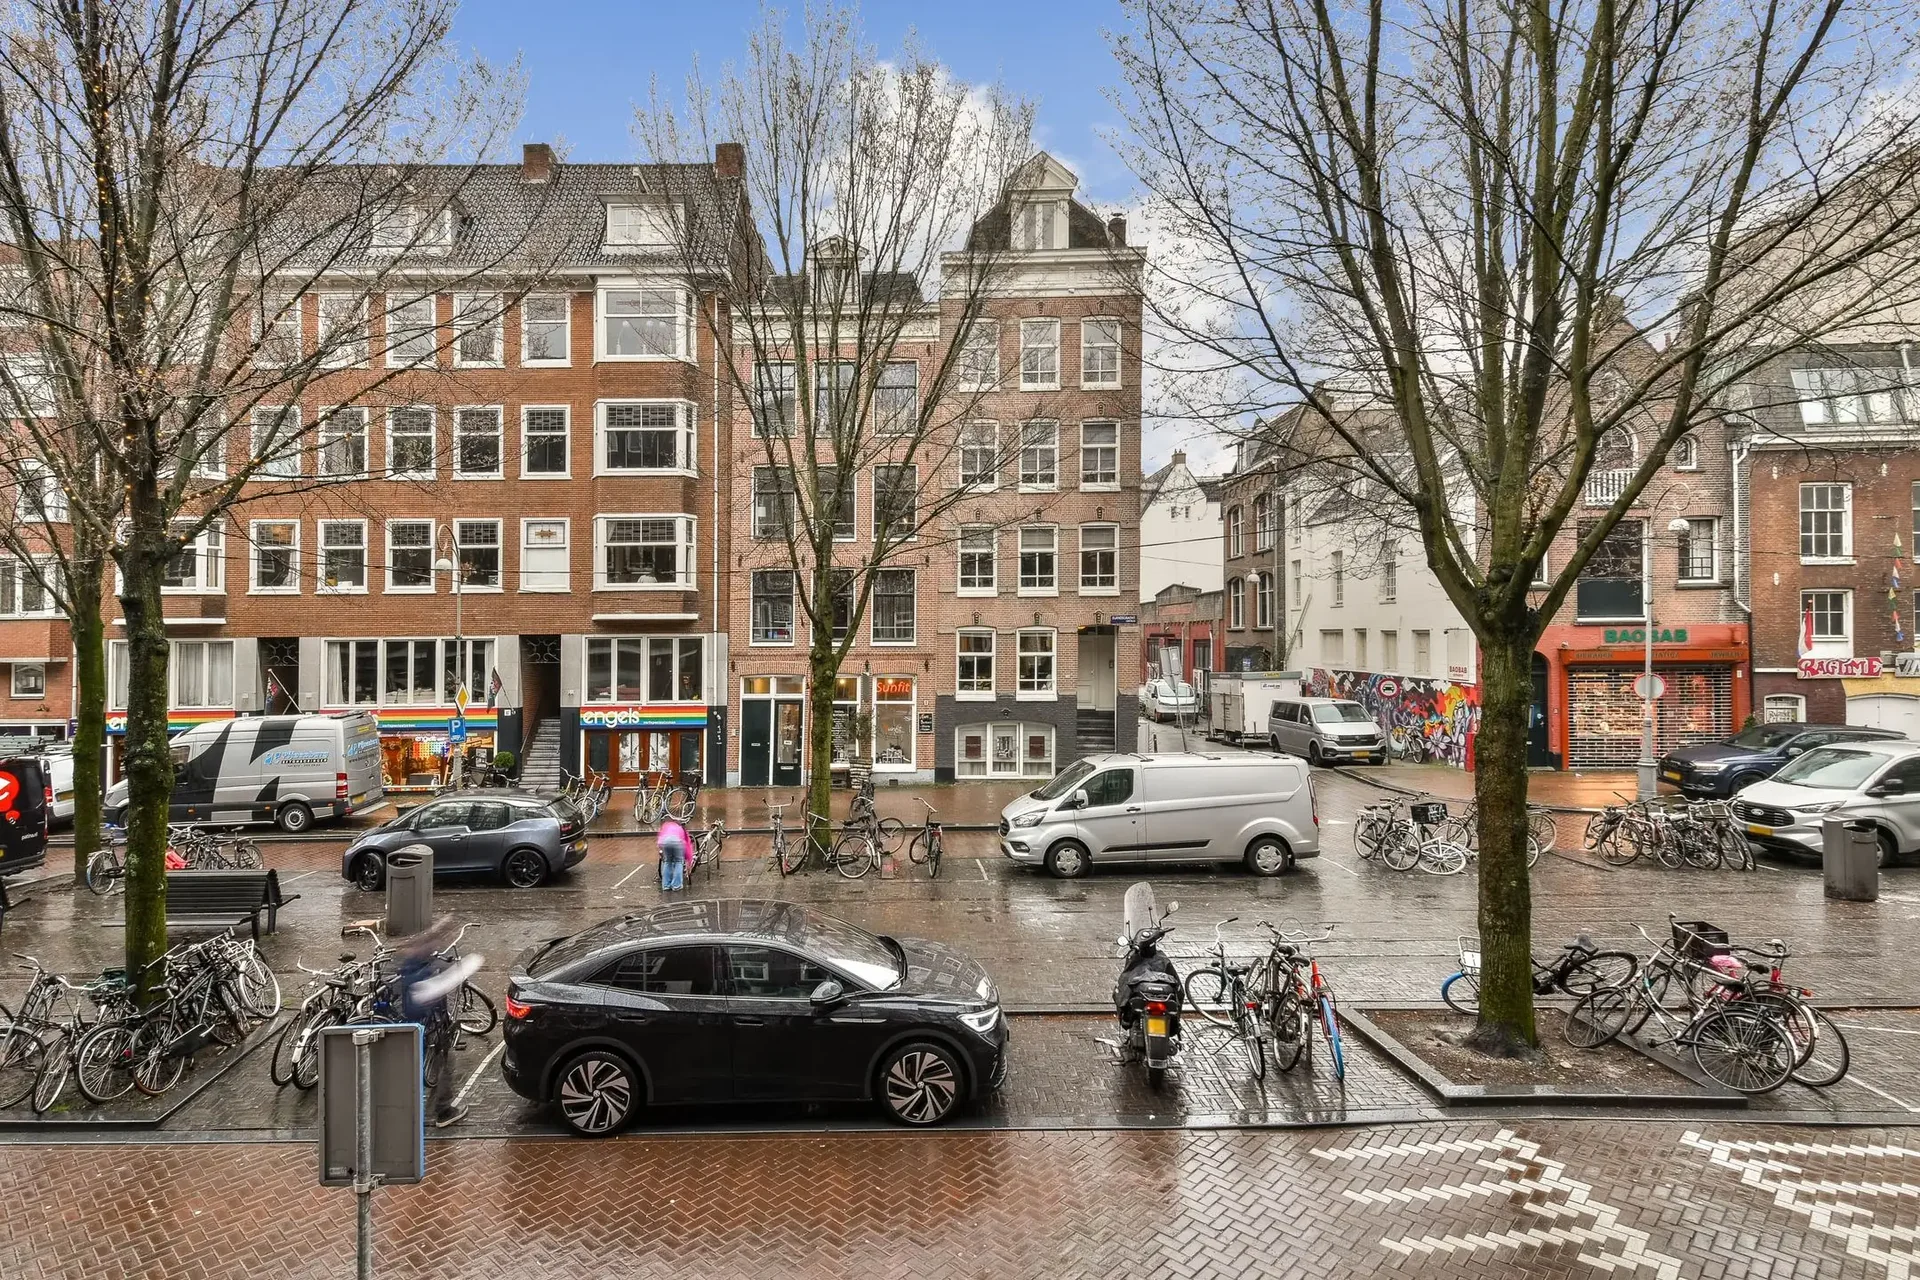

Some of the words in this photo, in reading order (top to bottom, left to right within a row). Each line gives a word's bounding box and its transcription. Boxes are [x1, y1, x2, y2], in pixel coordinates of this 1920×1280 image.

[1604, 629, 1688, 643] BAOBAB
[1798, 657, 1883, 677] RAGTIME
[876, 681, 911, 693] Sunfit
[582, 708, 640, 728] engels
[451, 720, 461, 733] P
